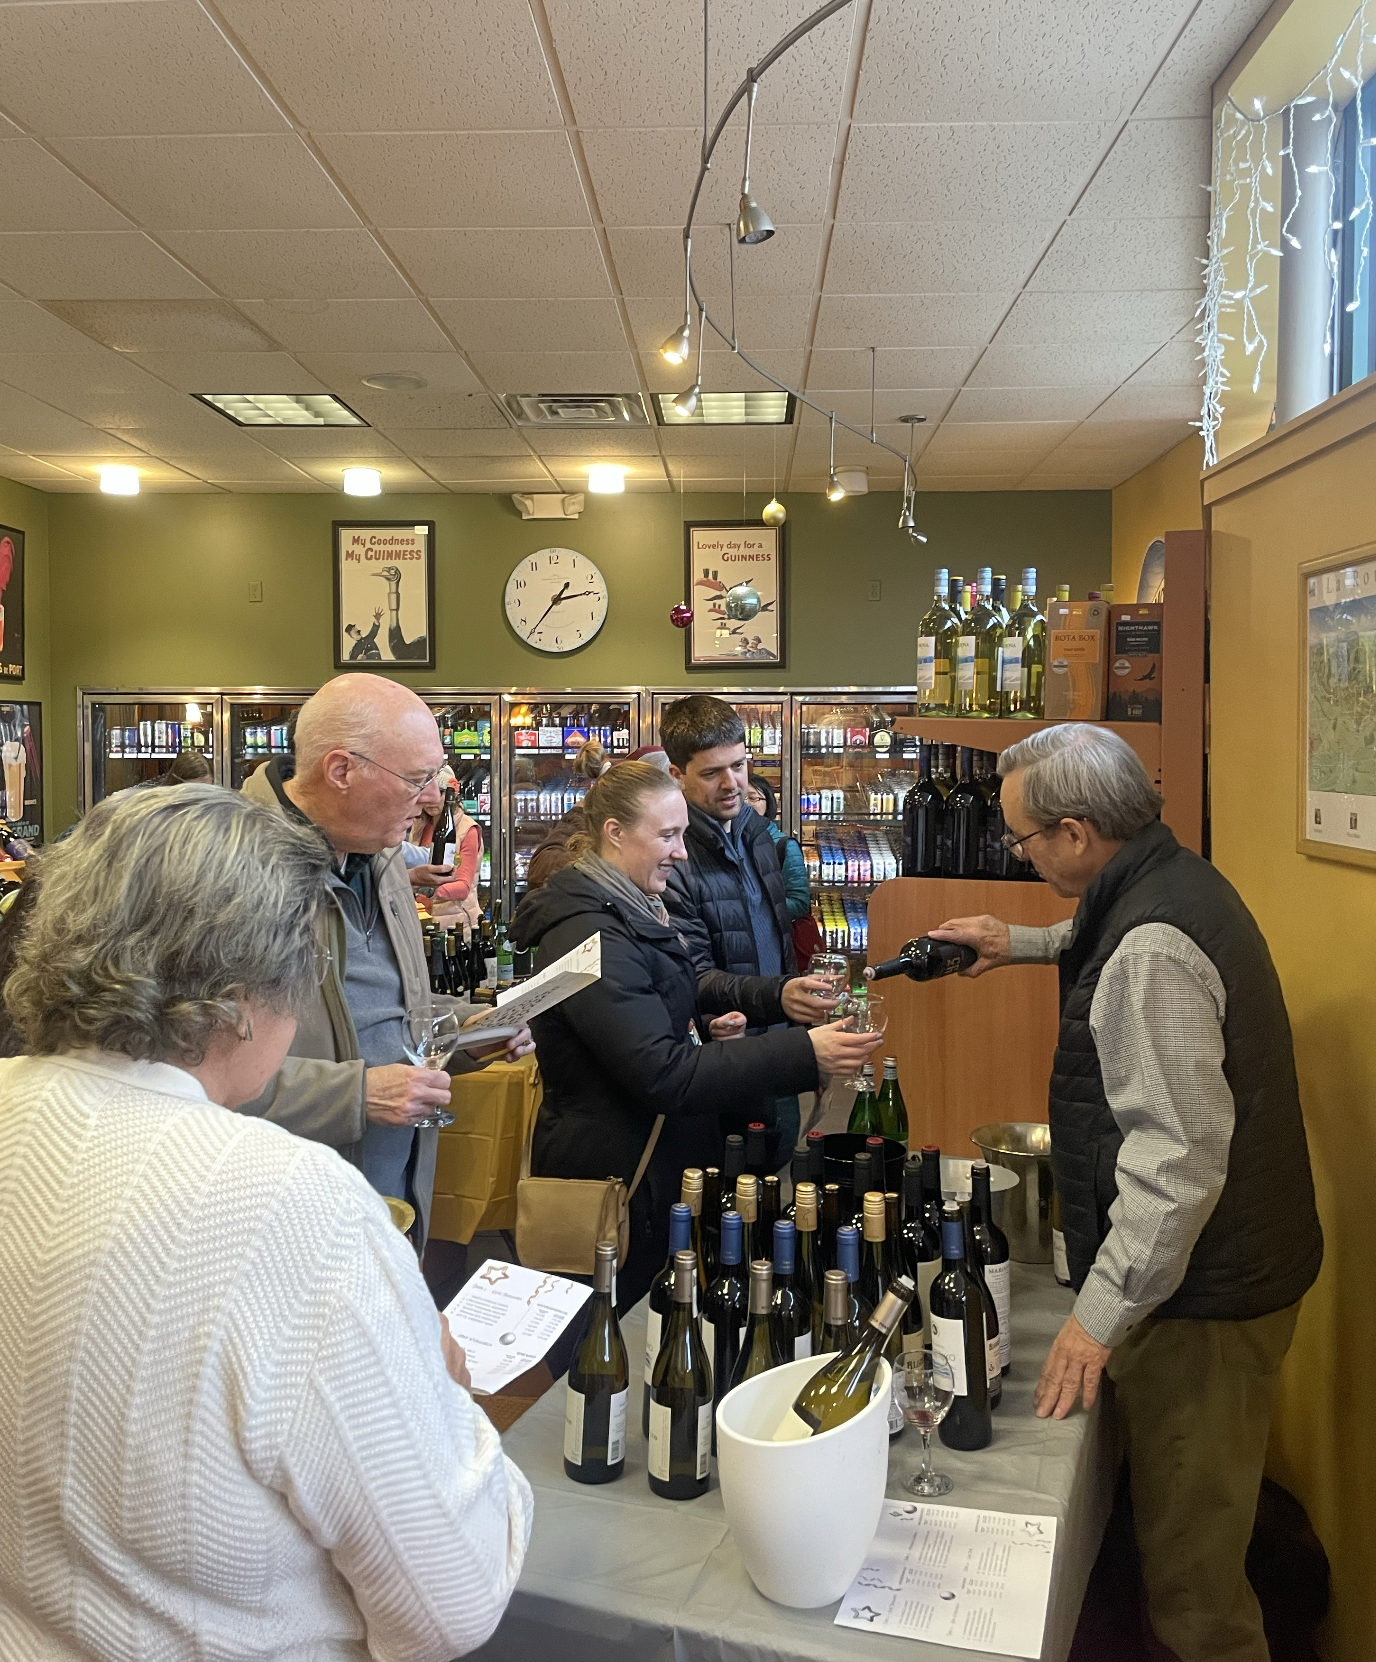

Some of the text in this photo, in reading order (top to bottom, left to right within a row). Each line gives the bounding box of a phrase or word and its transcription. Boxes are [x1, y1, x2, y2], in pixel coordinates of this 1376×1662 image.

[351, 535, 415, 548] My Goodness
[696, 540, 724, 551] Lovely
[726, 540, 742, 551] day
[744, 540, 756, 549] for
[345, 547, 422, 563] My GUINNESS
[548, 554, 560, 565] 12
[721, 552, 772, 562] GUINNESS
[530, 561, 538, 572] 11
[586, 573, 595, 584] 2
[515, 579, 527, 590] 10
[519, 617, 527, 626] 8
[1055, 634, 1096, 642] BOTA BOX
[9, 664, 23, 677] PORT
